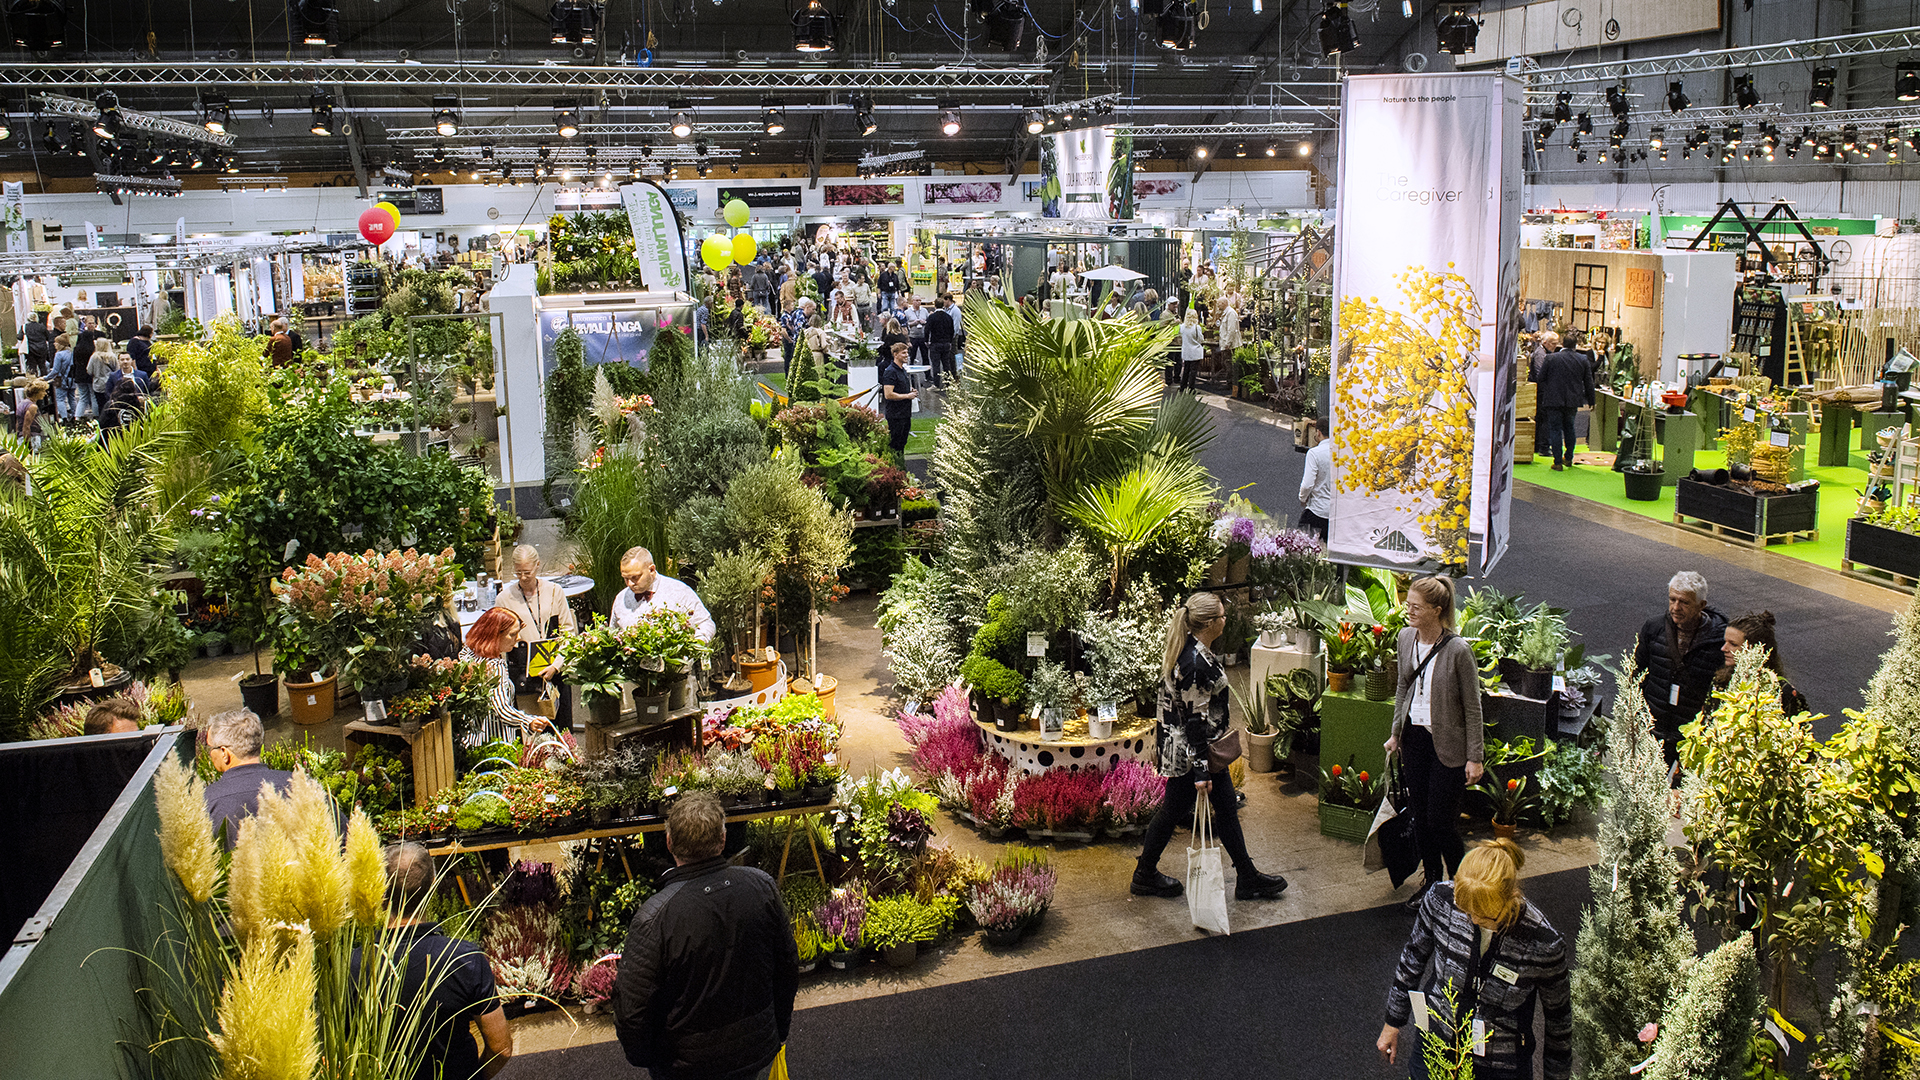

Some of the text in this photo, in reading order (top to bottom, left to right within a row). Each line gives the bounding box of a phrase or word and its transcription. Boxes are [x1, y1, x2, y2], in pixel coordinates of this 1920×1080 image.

[1431, 95, 1456, 103] people
[1377, 172, 1408, 186] The
[1376, 187, 1463, 205] Caregiver
